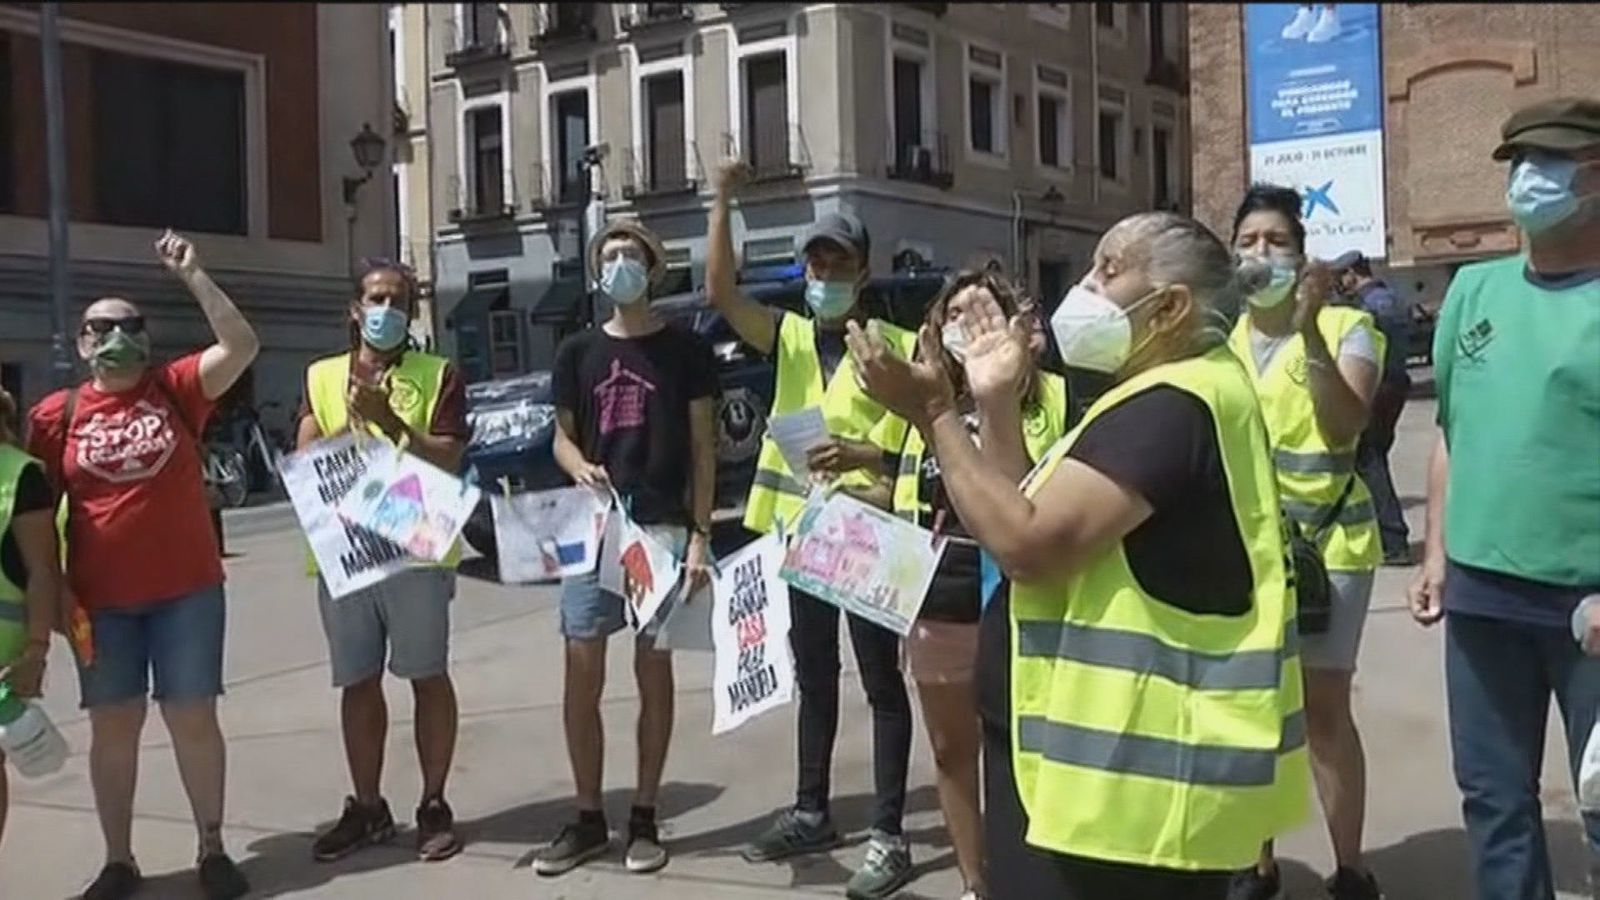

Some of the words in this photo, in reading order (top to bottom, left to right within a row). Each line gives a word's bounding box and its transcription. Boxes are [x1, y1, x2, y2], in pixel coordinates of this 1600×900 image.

[1324, 144, 1367, 159] OCTUBRE
[89, 415, 161, 449] STOP
[737, 611, 768, 652] CASA
